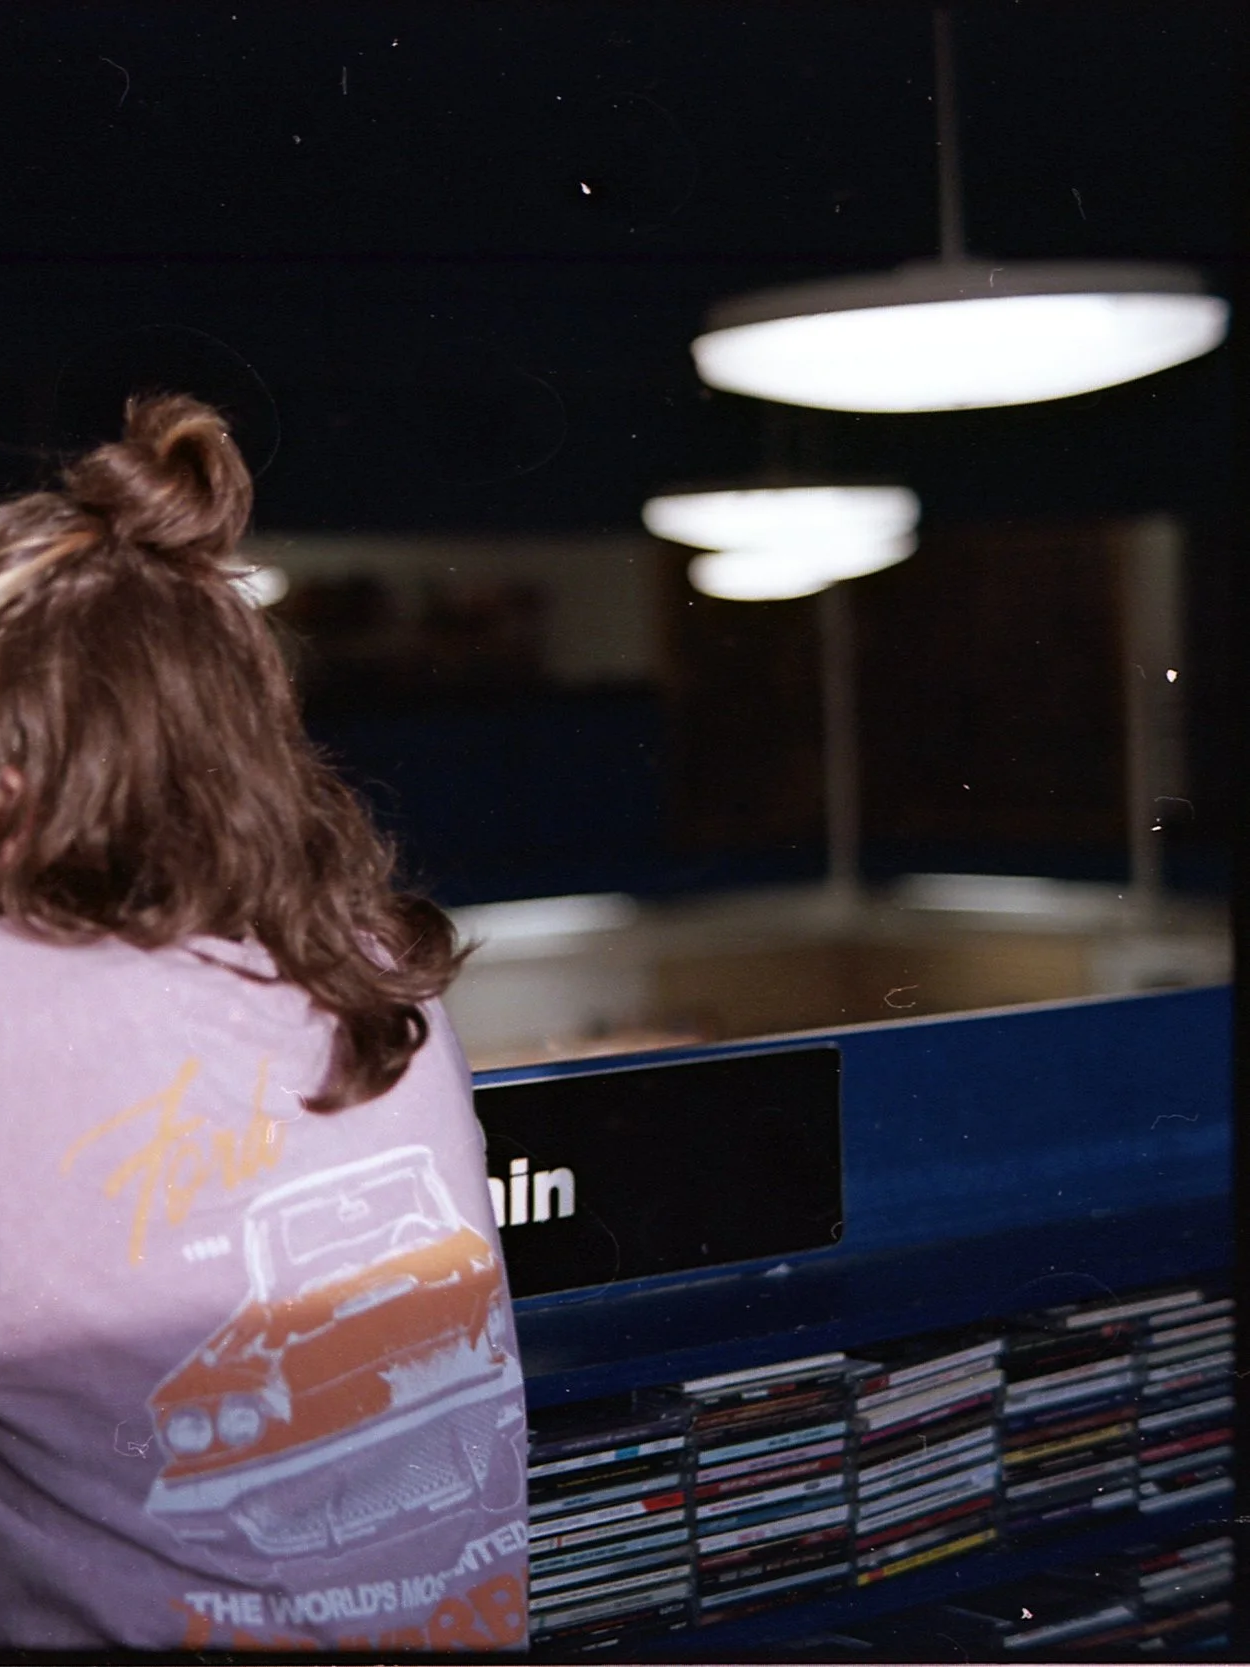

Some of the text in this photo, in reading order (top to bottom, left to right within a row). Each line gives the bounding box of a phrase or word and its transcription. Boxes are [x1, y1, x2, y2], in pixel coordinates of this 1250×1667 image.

[184, 1592, 263, 1626] THE
[269, 1578, 400, 1626] WORLD'S
[453, 1519, 528, 1577] NTED
